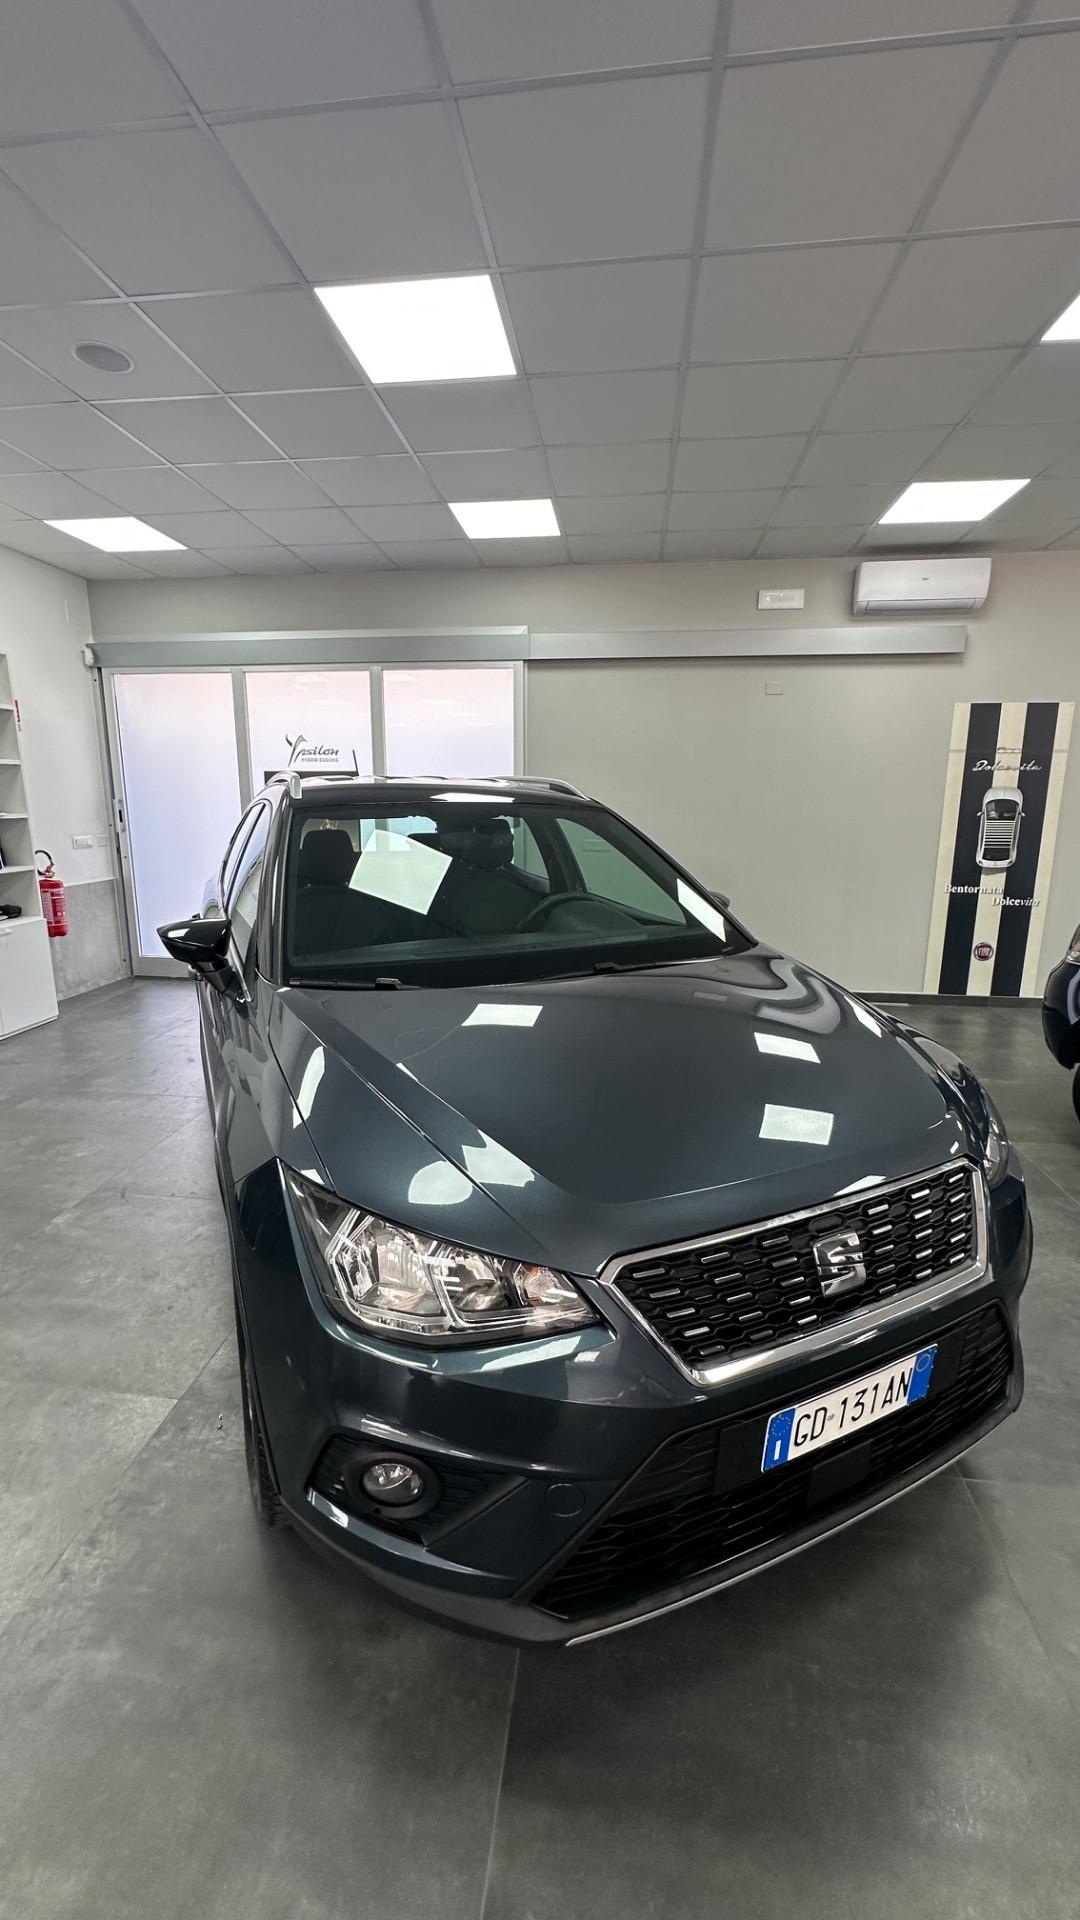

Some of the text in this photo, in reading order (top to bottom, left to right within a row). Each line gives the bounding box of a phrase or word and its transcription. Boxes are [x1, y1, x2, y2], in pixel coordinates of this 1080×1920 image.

[285, 734, 339, 767] Ypsilon
[944, 884, 1005, 895] Bentornata
[991, 896, 1040, 907] Dolcevita
